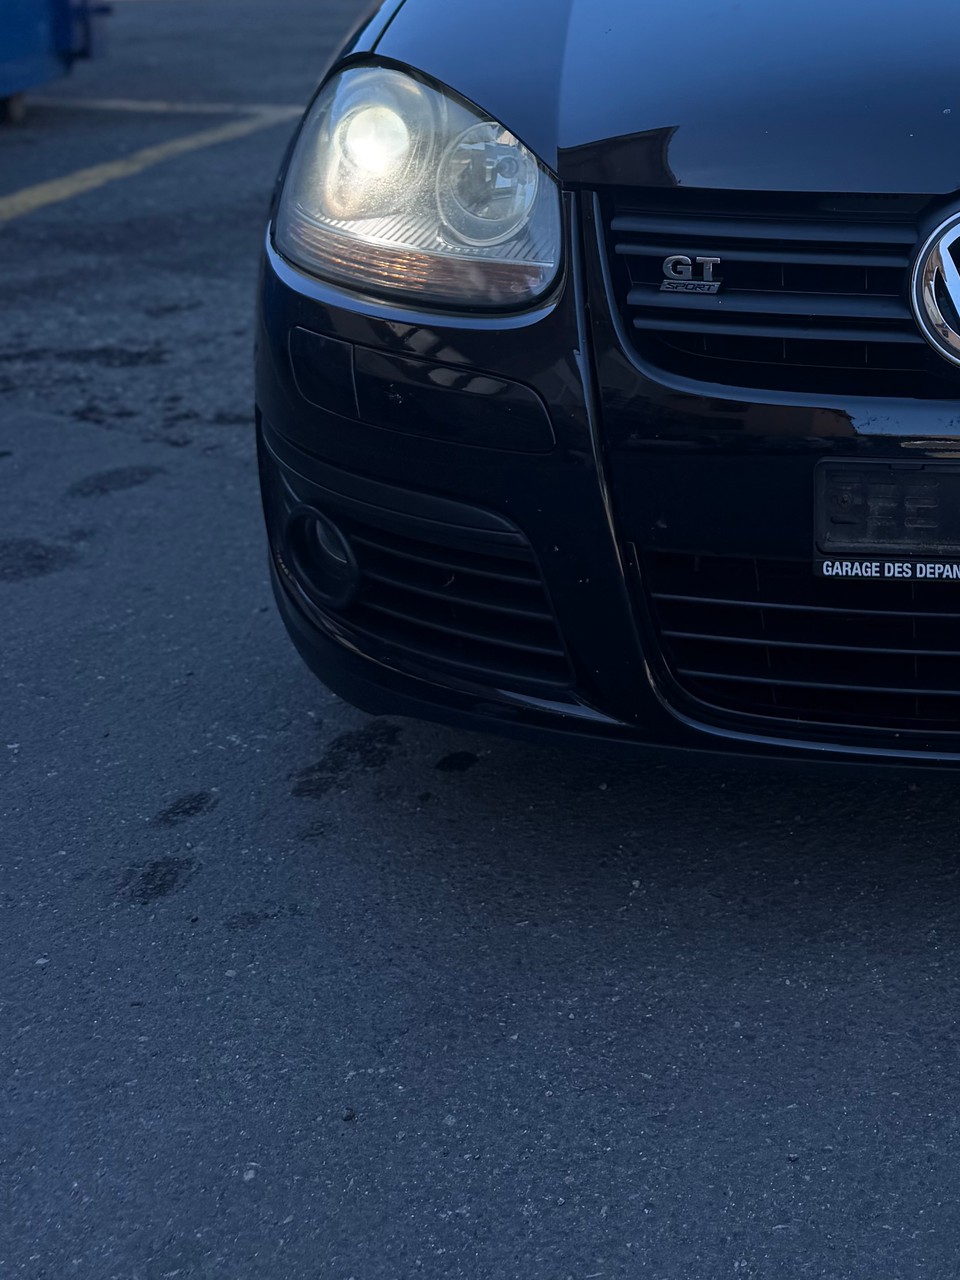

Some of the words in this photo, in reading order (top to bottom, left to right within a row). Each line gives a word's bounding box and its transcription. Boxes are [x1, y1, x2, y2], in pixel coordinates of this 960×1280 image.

[662, 254, 721, 282] GT
[665, 281, 716, 293] SPORT
[822, 560, 880, 577] GARAGE
[884, 562, 912, 578] DES
